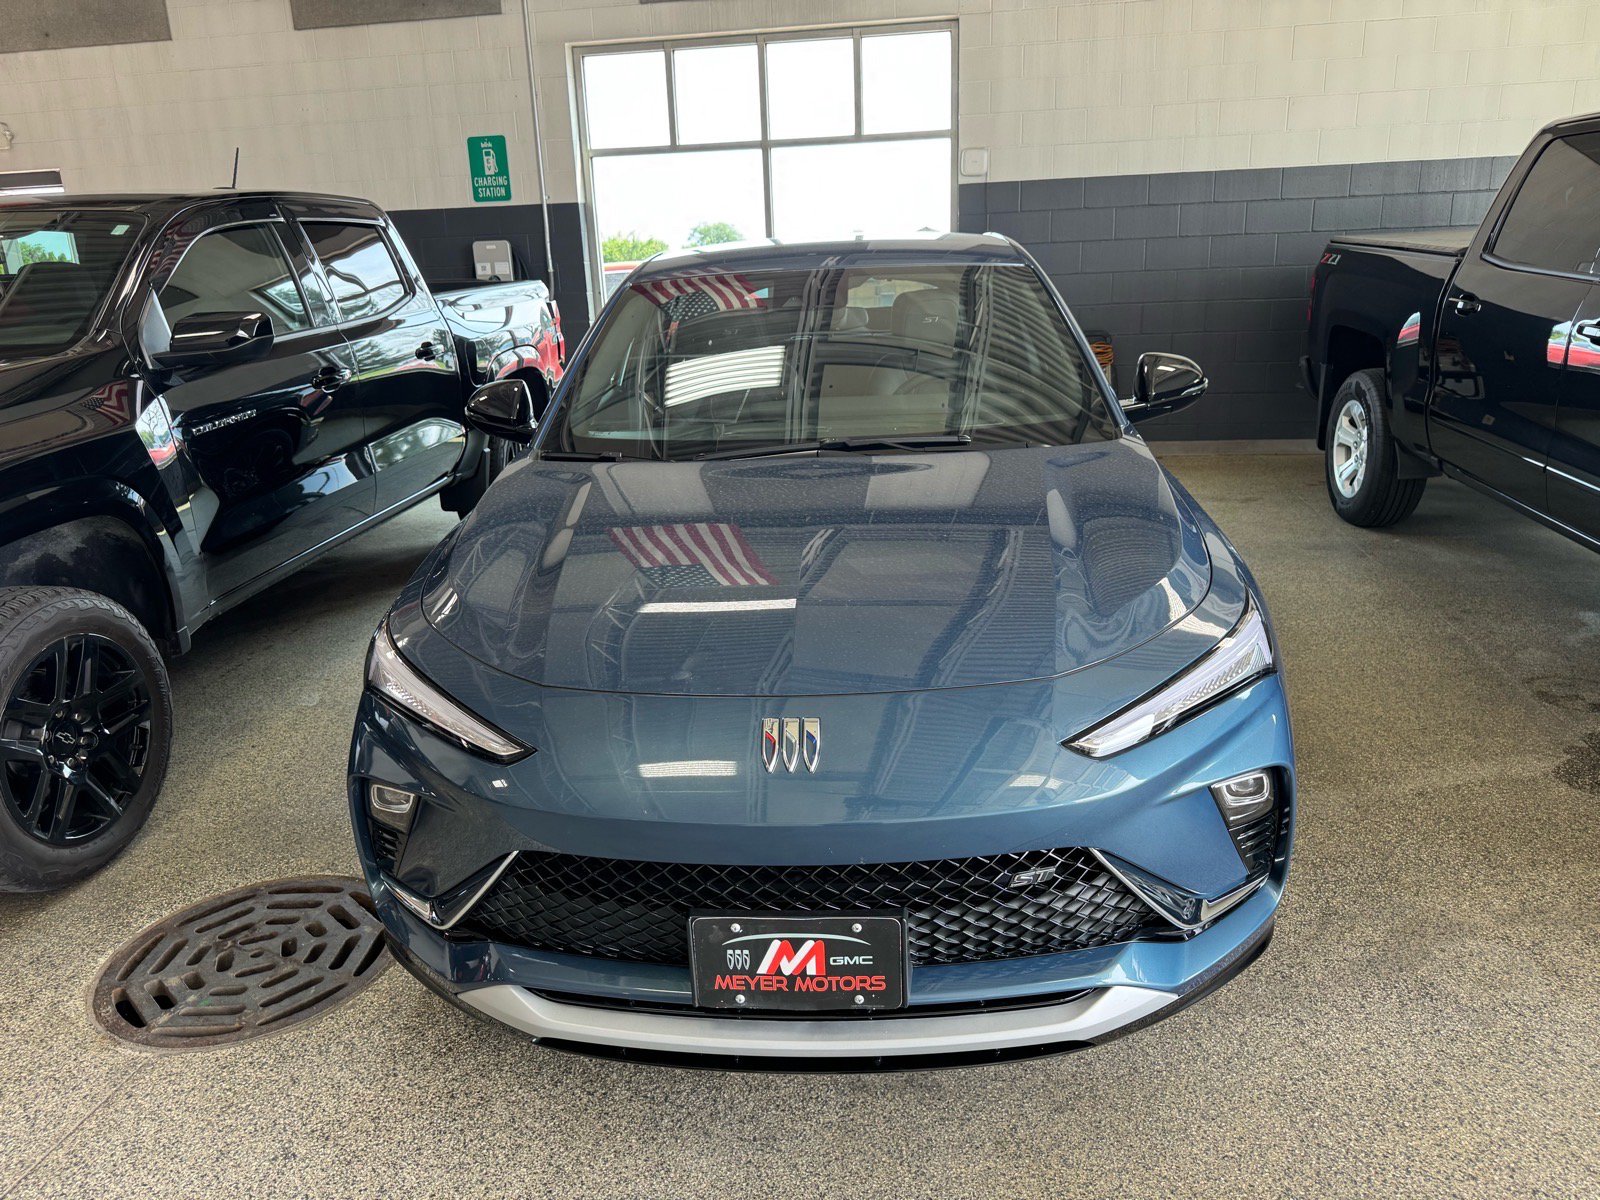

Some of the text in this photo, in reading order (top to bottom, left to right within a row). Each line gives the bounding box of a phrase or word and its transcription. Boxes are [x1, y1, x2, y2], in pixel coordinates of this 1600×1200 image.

[473, 175, 508, 187] CHARGING
[478, 186, 506, 198] STATION
[1010, 866, 1056, 888] ST
[829, 955, 874, 966] GMC
[714, 974, 887, 992] MEYER MOTORS
